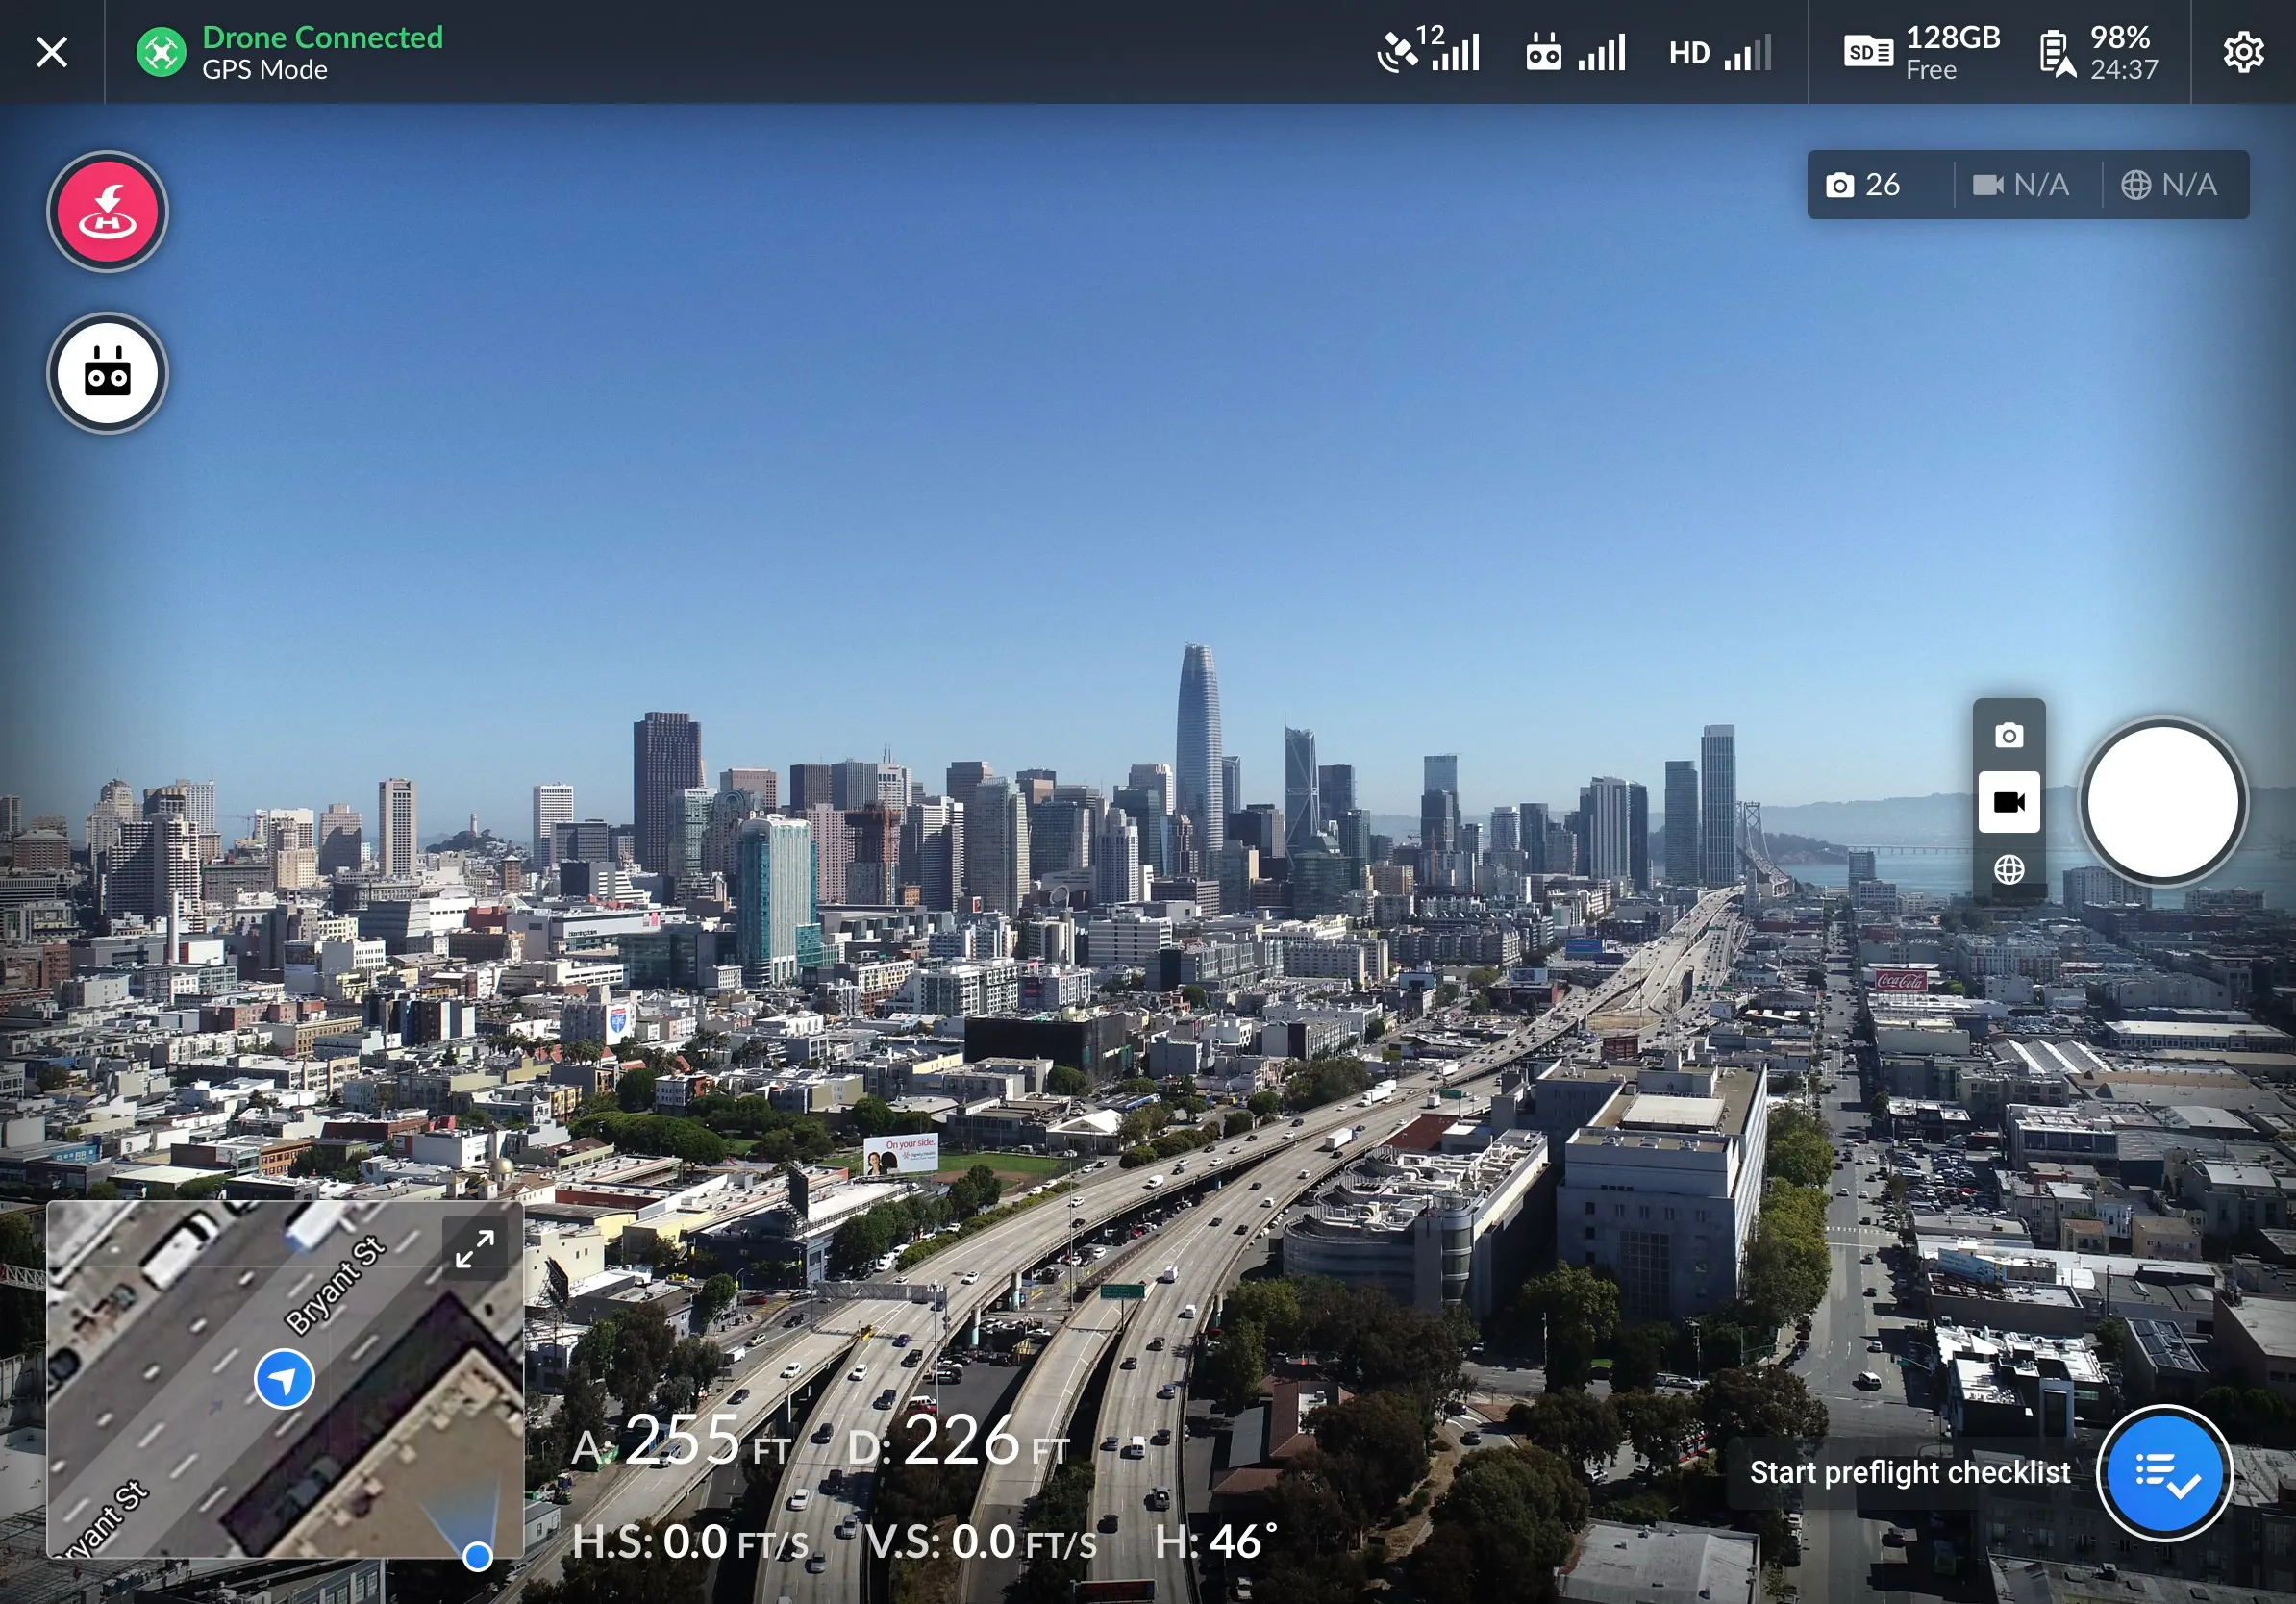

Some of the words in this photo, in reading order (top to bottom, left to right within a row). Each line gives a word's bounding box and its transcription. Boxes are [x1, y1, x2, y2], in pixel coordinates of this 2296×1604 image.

[886, 1140, 898, 1149] On
[899, 1140, 916, 1150] your
[917, 1138, 936, 1147] side.
